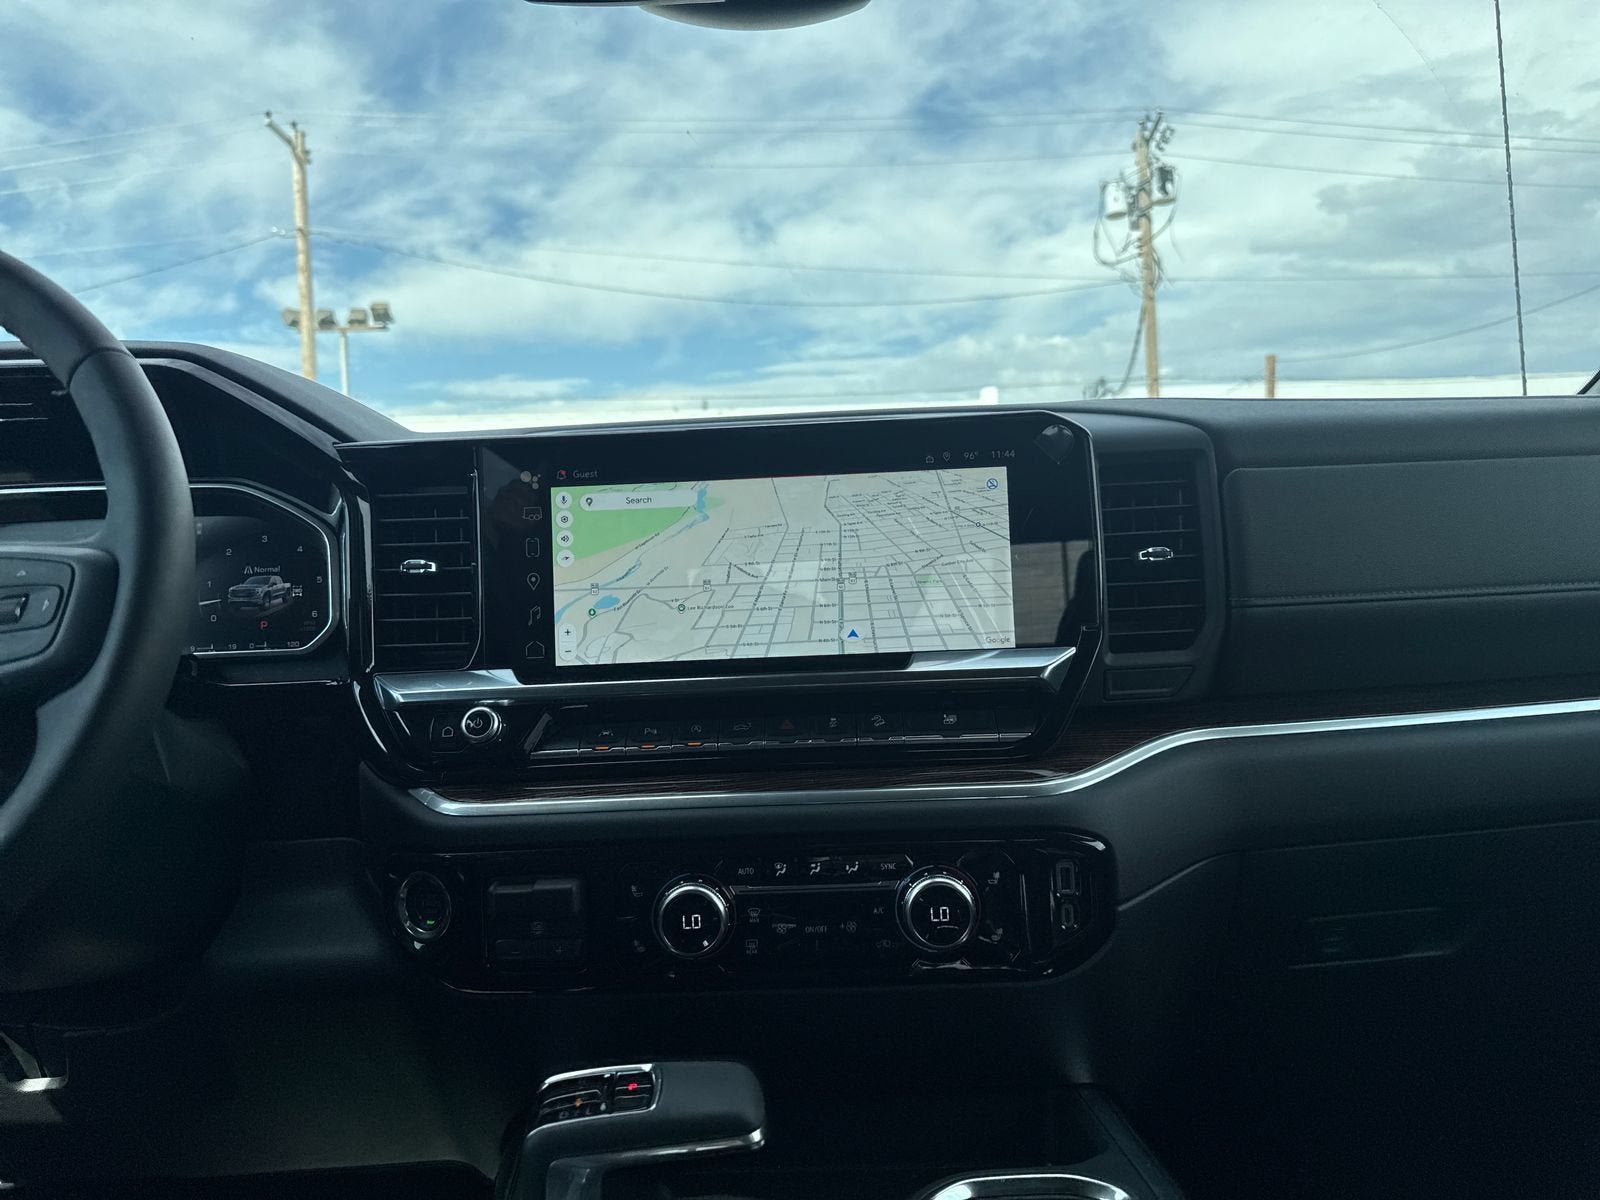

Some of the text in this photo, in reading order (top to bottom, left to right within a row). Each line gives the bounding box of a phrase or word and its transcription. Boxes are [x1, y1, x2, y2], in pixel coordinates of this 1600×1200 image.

[991, 449, 1015, 458] 11:44
[573, 470, 598, 478] Guest
[625, 496, 652, 505] Search
[261, 621, 268, 629] P
[985, 635, 1011, 645] Google
[737, 862, 897, 875] AUTO SYNC
[873, 906, 885, 914] A/C
